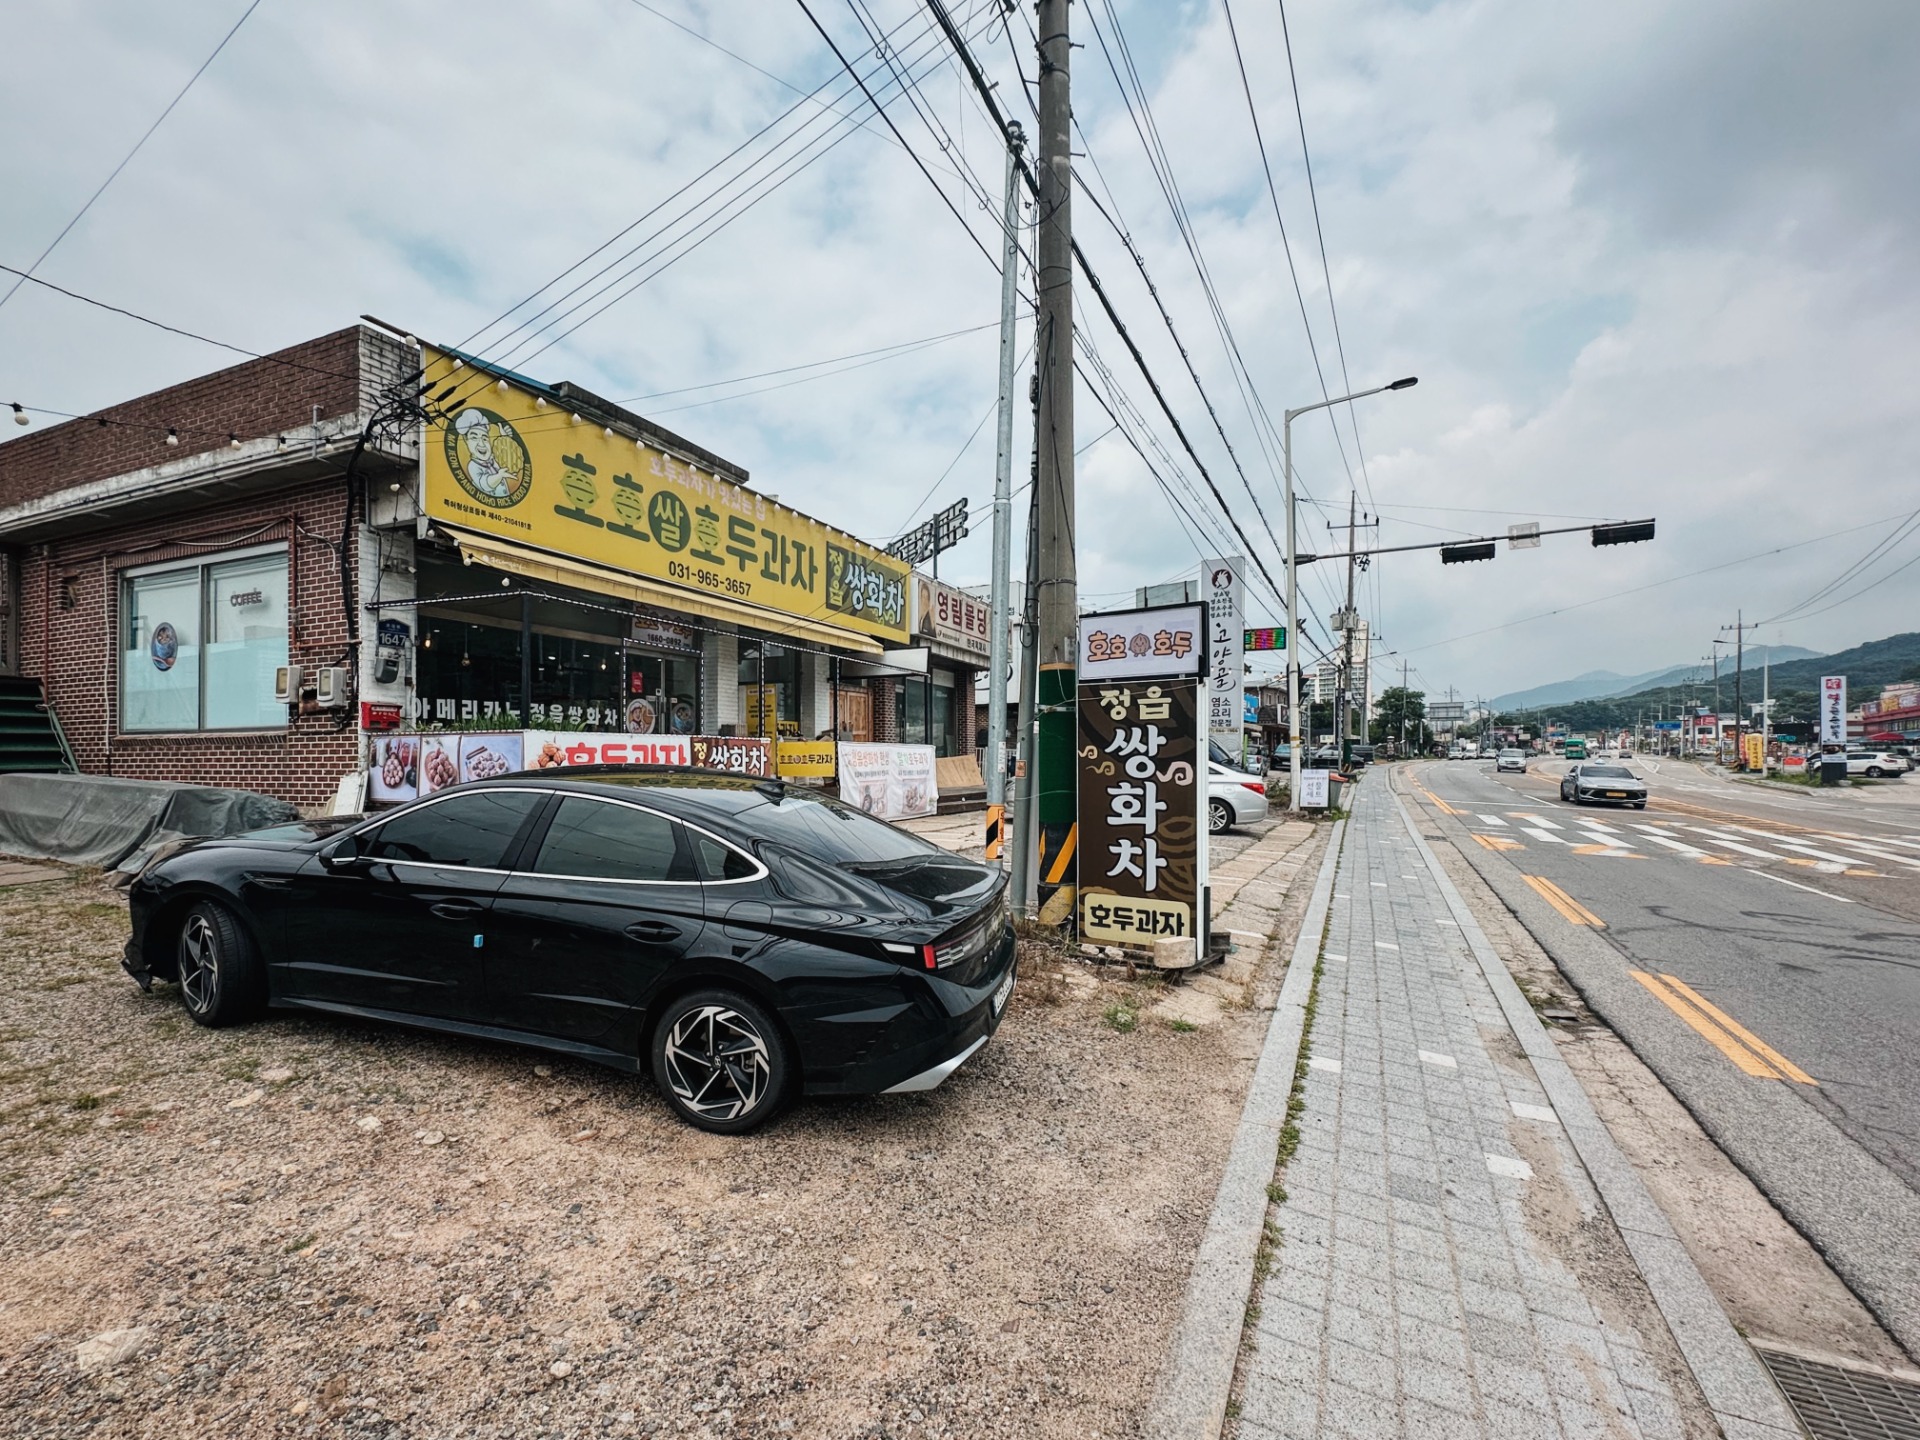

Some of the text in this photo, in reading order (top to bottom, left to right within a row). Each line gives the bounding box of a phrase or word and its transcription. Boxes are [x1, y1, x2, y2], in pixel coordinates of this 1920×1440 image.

[668, 561, 752, 597] 031-965-3657
[845, 563, 905, 624] 쌍화차
[230, 590, 263, 607] COFFEE
[937, 591, 987, 636] 영림몰딩
[379, 632, 407, 646] 1647
[1088, 629, 1193, 662] 호호 호두
[1099, 686, 1172, 720] 정읍
[1211, 697, 1232, 708] 염소
[1211, 709, 1231, 718] 요리
[1105, 724, 1168, 892] 쌍화차
[1090, 904, 1185, 937] 호두과자
